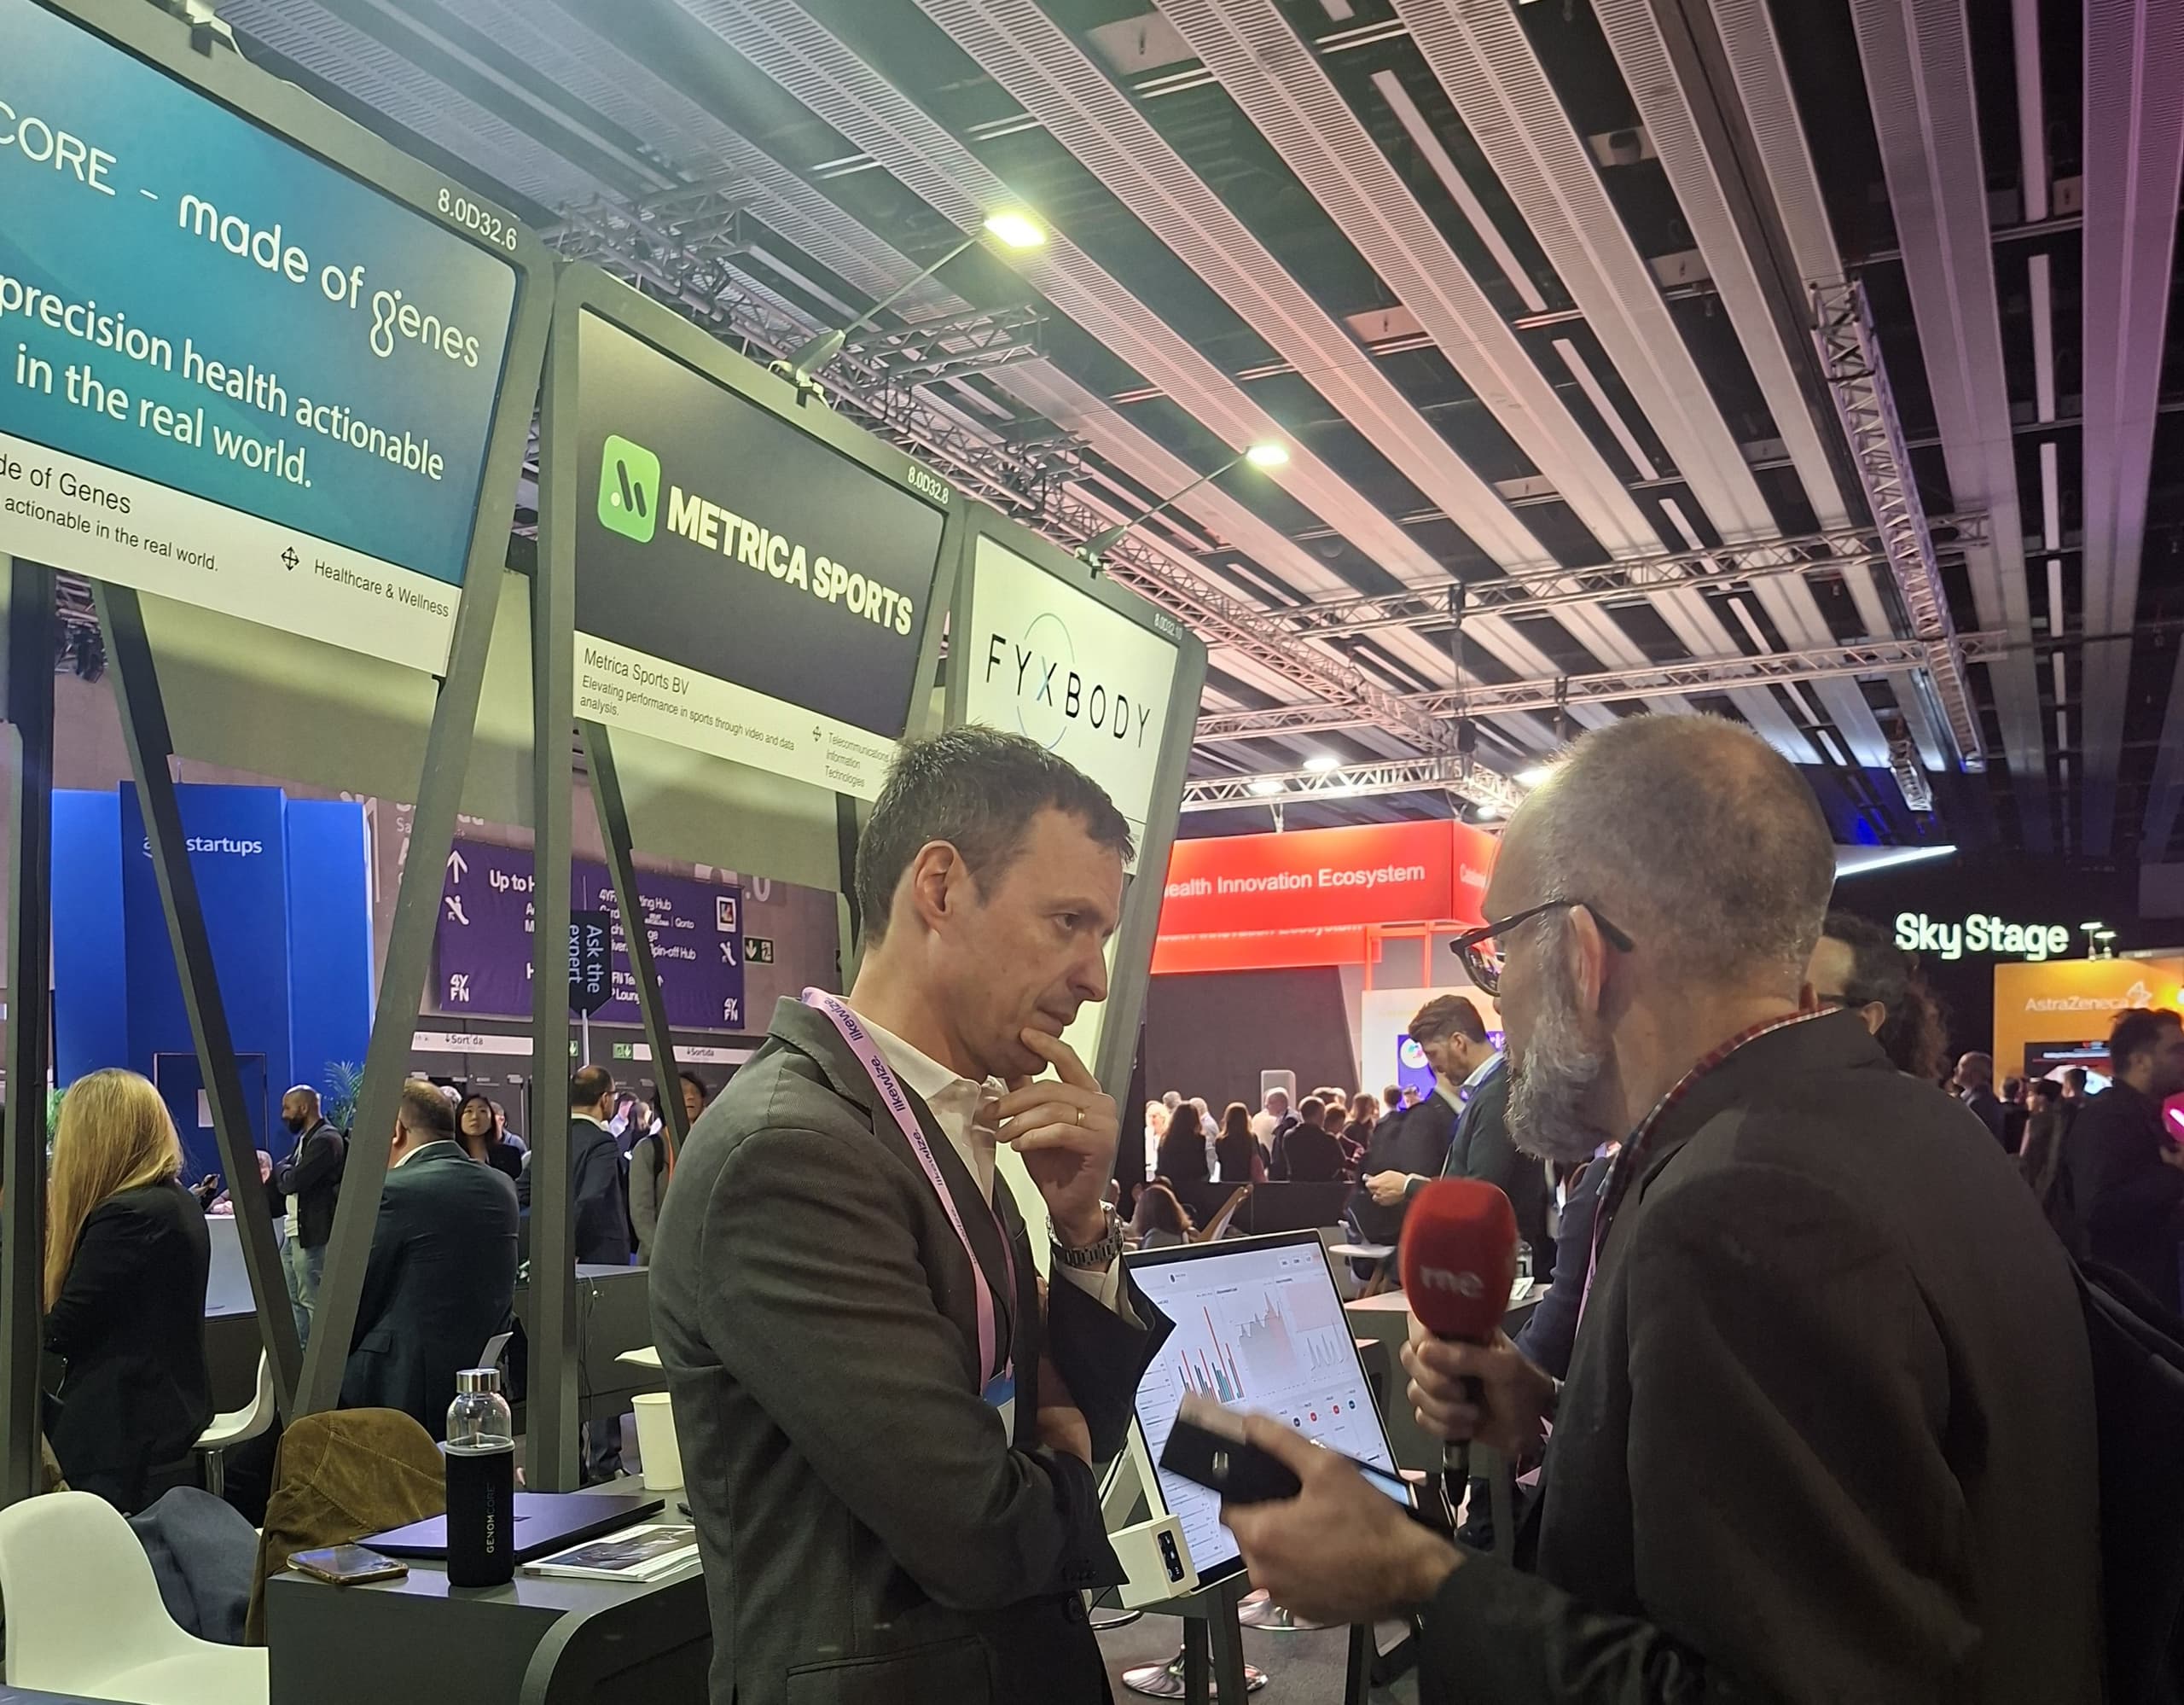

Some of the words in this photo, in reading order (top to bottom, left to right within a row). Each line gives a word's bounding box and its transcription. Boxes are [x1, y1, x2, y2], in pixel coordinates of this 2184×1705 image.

[438, 188, 517, 251] 8.0D32.6
[179, 194, 309, 283] made
[321, 265, 366, 309] of
[369, 289, 479, 368] genes
[0, 273, 172, 372] precision
[183, 338, 288, 417] health
[295, 396, 445, 481] actionable
[16, 343, 53, 394] in
[65, 364, 129, 420] the
[139, 399, 203, 448] real
[212, 424, 313, 488] world.
[30, 468, 52, 489] of
[60, 473, 131, 514] Genes
[908, 466, 949, 504] 8.0D32.8
[5, 498, 90, 533] actionable
[96, 520, 109, 539] in
[115, 527, 138, 547] the
[144, 538, 171, 558] real
[177, 548, 218, 571] world.
[667, 485, 809, 591] METRICA
[812, 556, 914, 636] SPORTS
[315, 559, 382, 595] Healthcare
[386, 584, 394, 599] &
[398, 587, 450, 618] Wellness
[584, 648, 629, 677] Metrica
[632, 664, 670, 690] Sports
[672, 677, 689, 695] BV
[986, 633, 1150, 748] FYXBODY
[580, 696, 619, 716] analysis.
[582, 675, 624, 701] Elevating
[626, 690, 678, 715] performance
[680, 705, 688, 718] in
[689, 710, 713, 726] sports
[715, 717, 743, 736] through
[745, 726, 764, 742] video
[765, 734, 778, 746] and
[780, 738, 794, 751] data
[185, 836, 263, 857] startups
[490, 870, 509, 893] Up
[512, 874, 526, 892] to
[1165, 877, 1211, 898] ealth
[1217, 872, 1312, 894] Innovation
[1318, 864, 1426, 888] Ecosystem
[586, 924, 604, 957] Ask
[1895, 912, 1962, 960] Sky
[1965, 913, 2071, 961] Stage
[450, 986, 469, 1002] FN
[586, 963, 604, 993] the
[2025, 995, 2129, 1011] AstraZeneca
